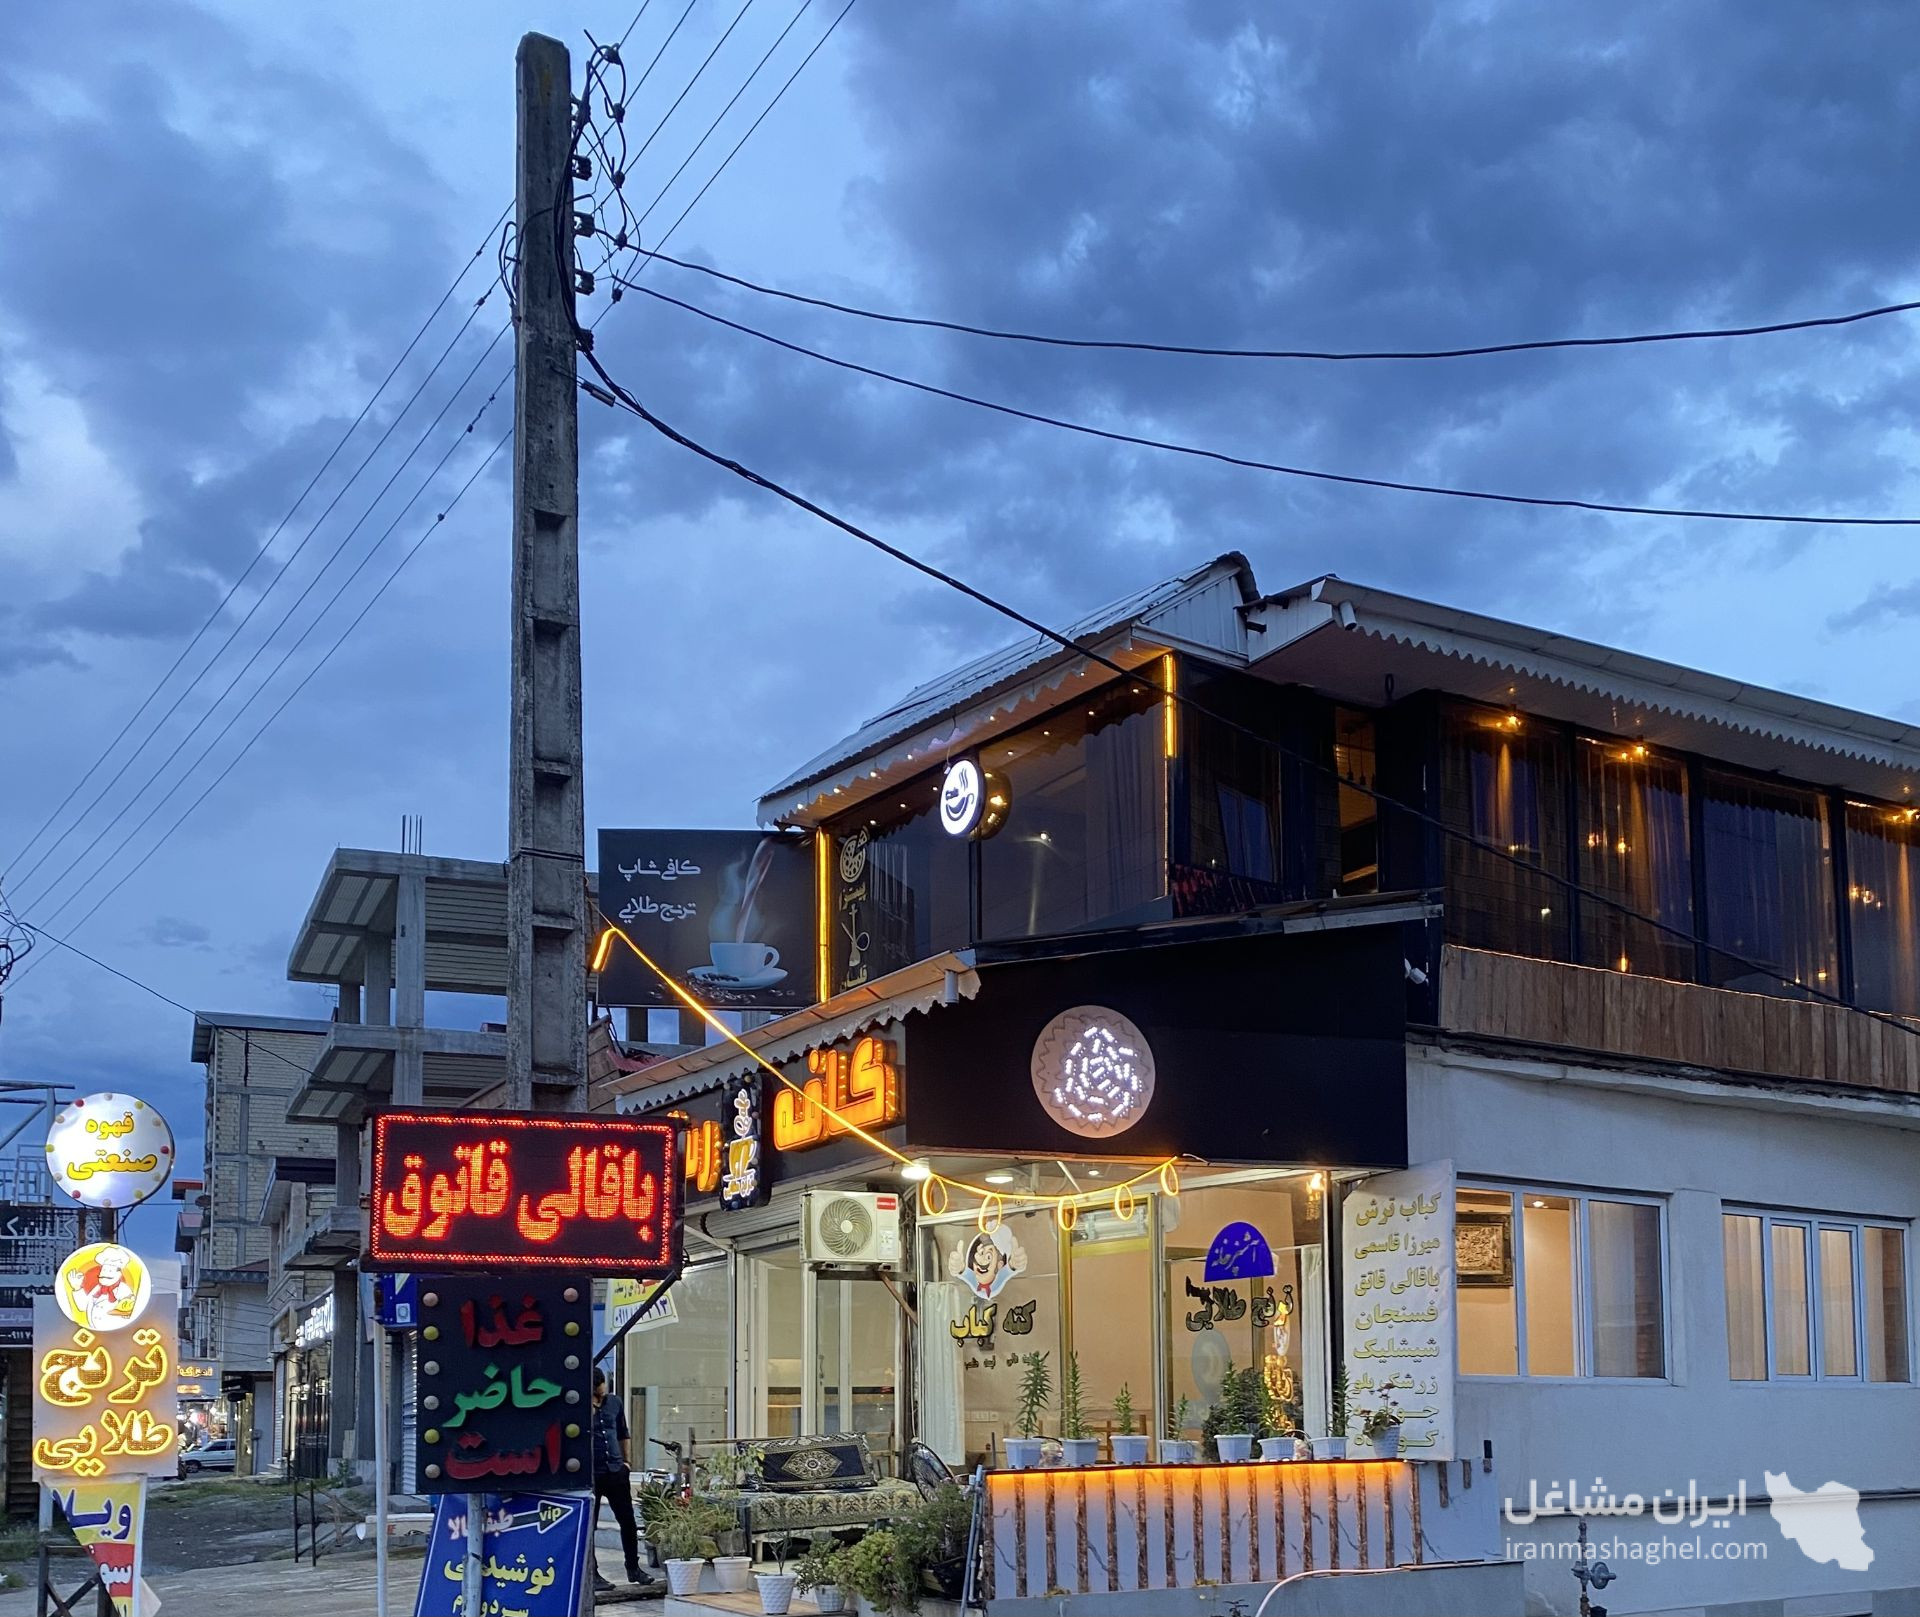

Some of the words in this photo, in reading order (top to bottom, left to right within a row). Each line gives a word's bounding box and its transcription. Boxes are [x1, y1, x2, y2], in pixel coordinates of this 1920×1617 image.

[618, 858, 660, 881] شاپ
[661, 858, 702, 880] کافی
[618, 895, 659, 924] طلایی
[660, 902, 697, 922] ترنج
[774, 1037, 895, 1151] کافه
[85, 1111, 134, 1140] قهوه
[66, 1149, 157, 1181] صنعتی
[382, 1140, 511, 1240] قاتوق
[518, 1145, 657, 1243] باقالی
[1356, 1197, 1395, 1226] ترش
[1400, 1191, 1441, 1222] کباب
[1354, 1232, 1400, 1259] قاسمی
[1404, 1232, 1441, 1256] میرزا
[1354, 1268, 1386, 1297] قاتق
[1390, 1266, 1441, 1295] باقالی
[460, 1294, 543, 1348] غذا
[950, 1303, 998, 1348] کباب
[1355, 1300, 1439, 1331] فسنجان
[1353, 1337, 1440, 1363] شیشلیک
[40, 1327, 168, 1407] ترنج
[441, 1362, 562, 1428] حاضر
[33, 1409, 173, 1477] طلایی
[444, 1419, 562, 1480] است
[539, 1505, 562, 1522] vip
[444, 1553, 556, 1596] نوشیدی
